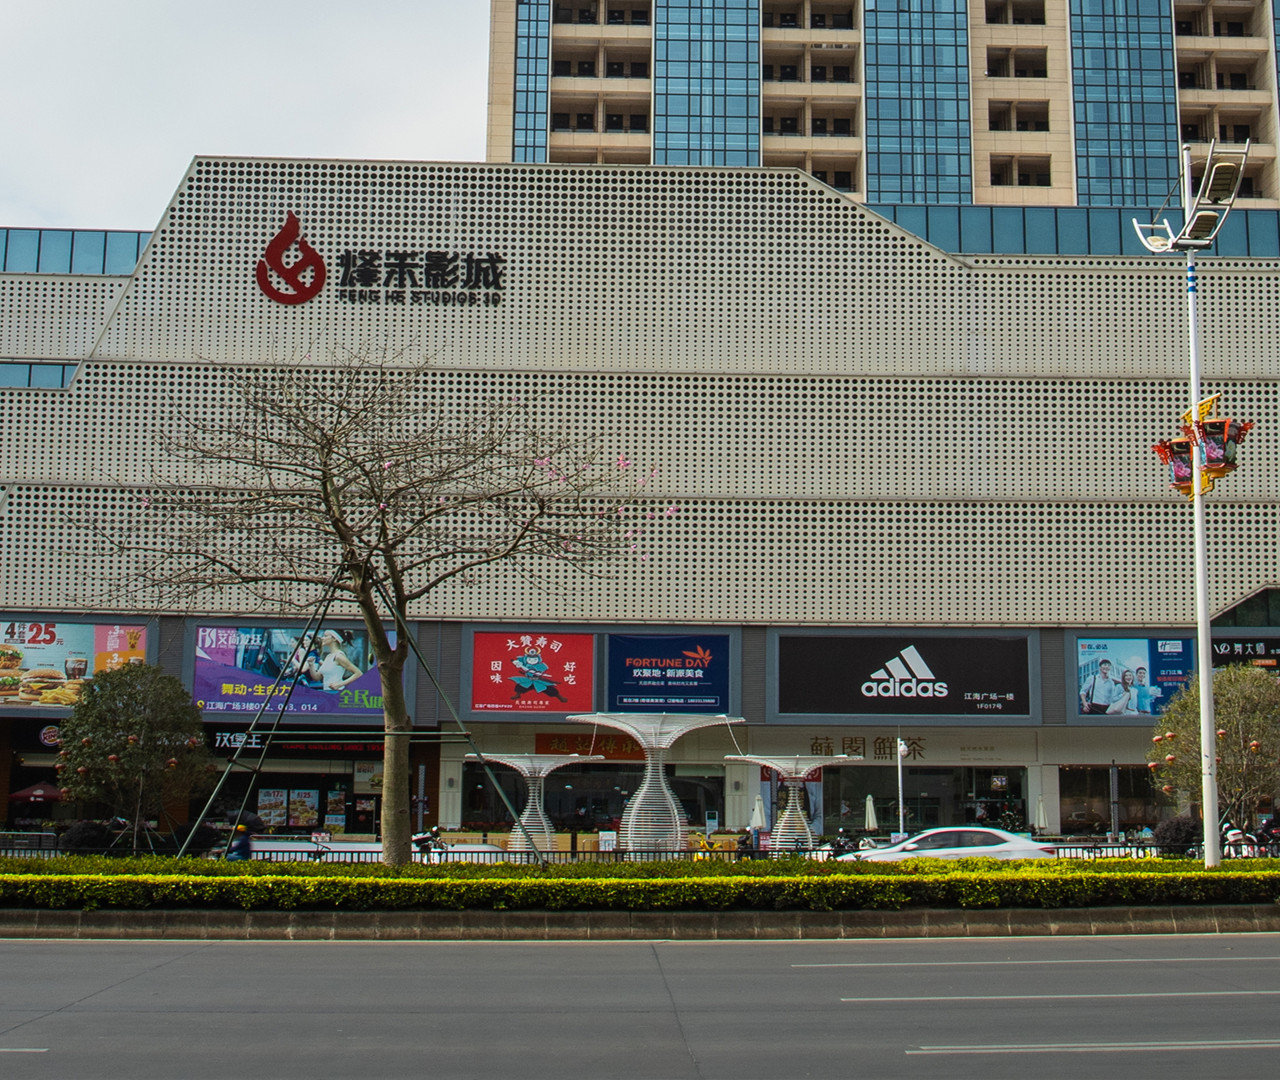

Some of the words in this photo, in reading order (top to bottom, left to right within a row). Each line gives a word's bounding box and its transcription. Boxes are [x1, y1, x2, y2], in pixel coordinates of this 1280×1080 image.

[339, 289, 381, 303] FENG
[385, 290, 407, 304] HE
[410, 291, 478, 305] STUDIOS
[482, 292, 502, 306] 3D
[625, 658, 683, 667] FORTUNE
[685, 658, 711, 668] DAY
[563, 661, 577, 685] 好吃
[861, 677, 948, 698] adidas
[964, 692, 1015, 701] 江海广场一楼
[215, 732, 263, 748] 汉堡王
